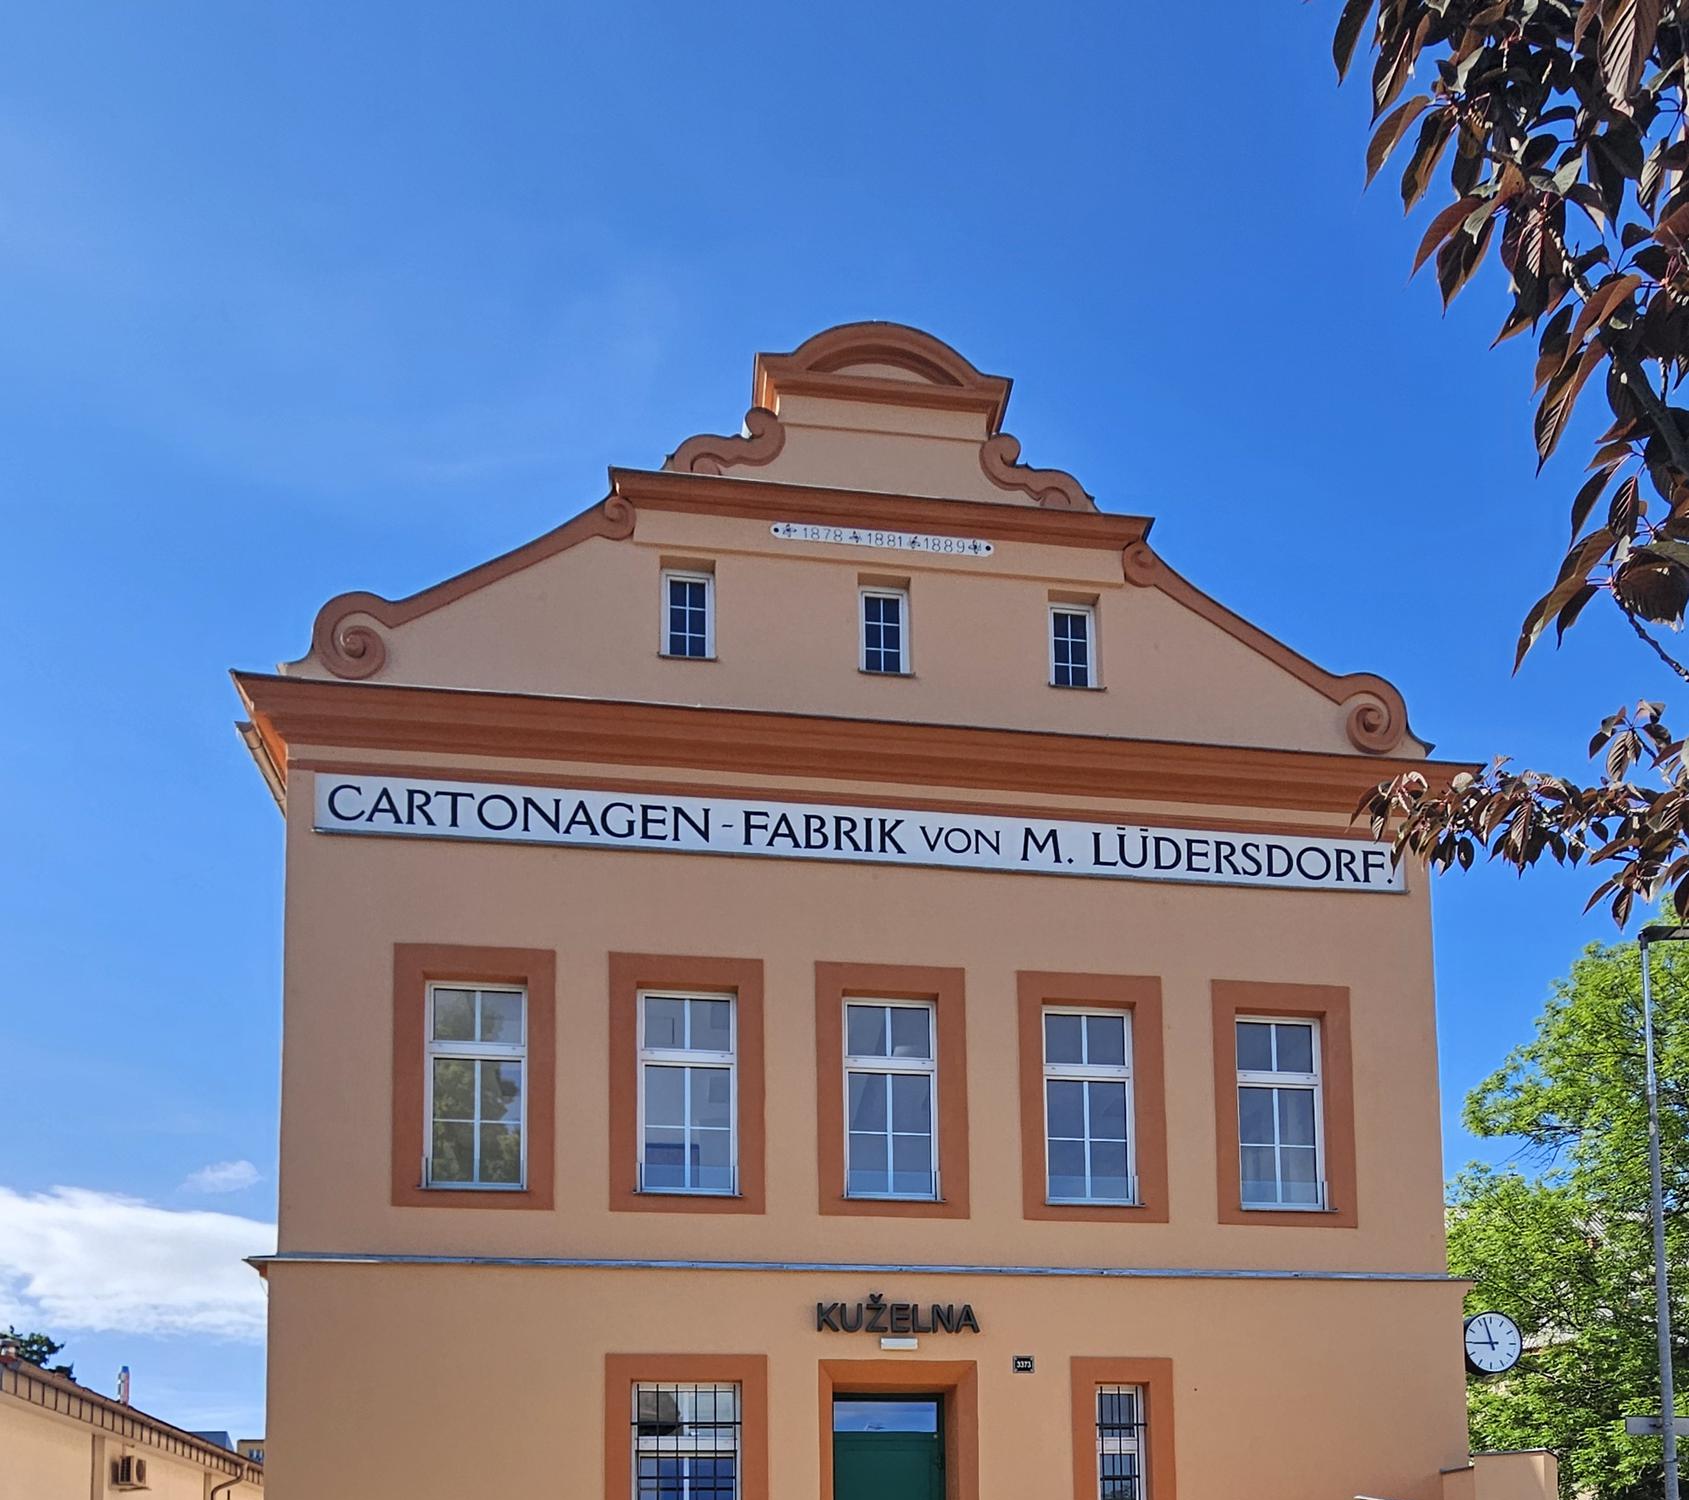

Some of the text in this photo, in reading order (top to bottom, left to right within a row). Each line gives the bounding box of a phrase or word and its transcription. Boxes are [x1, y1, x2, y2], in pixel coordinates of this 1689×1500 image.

[802, 526, 967, 555] 1878 1881 1889
[918, 825, 1001, 856] VON
[1019, 827, 1075, 866] M.
[816, 1293, 980, 1334] KUŽELNA
